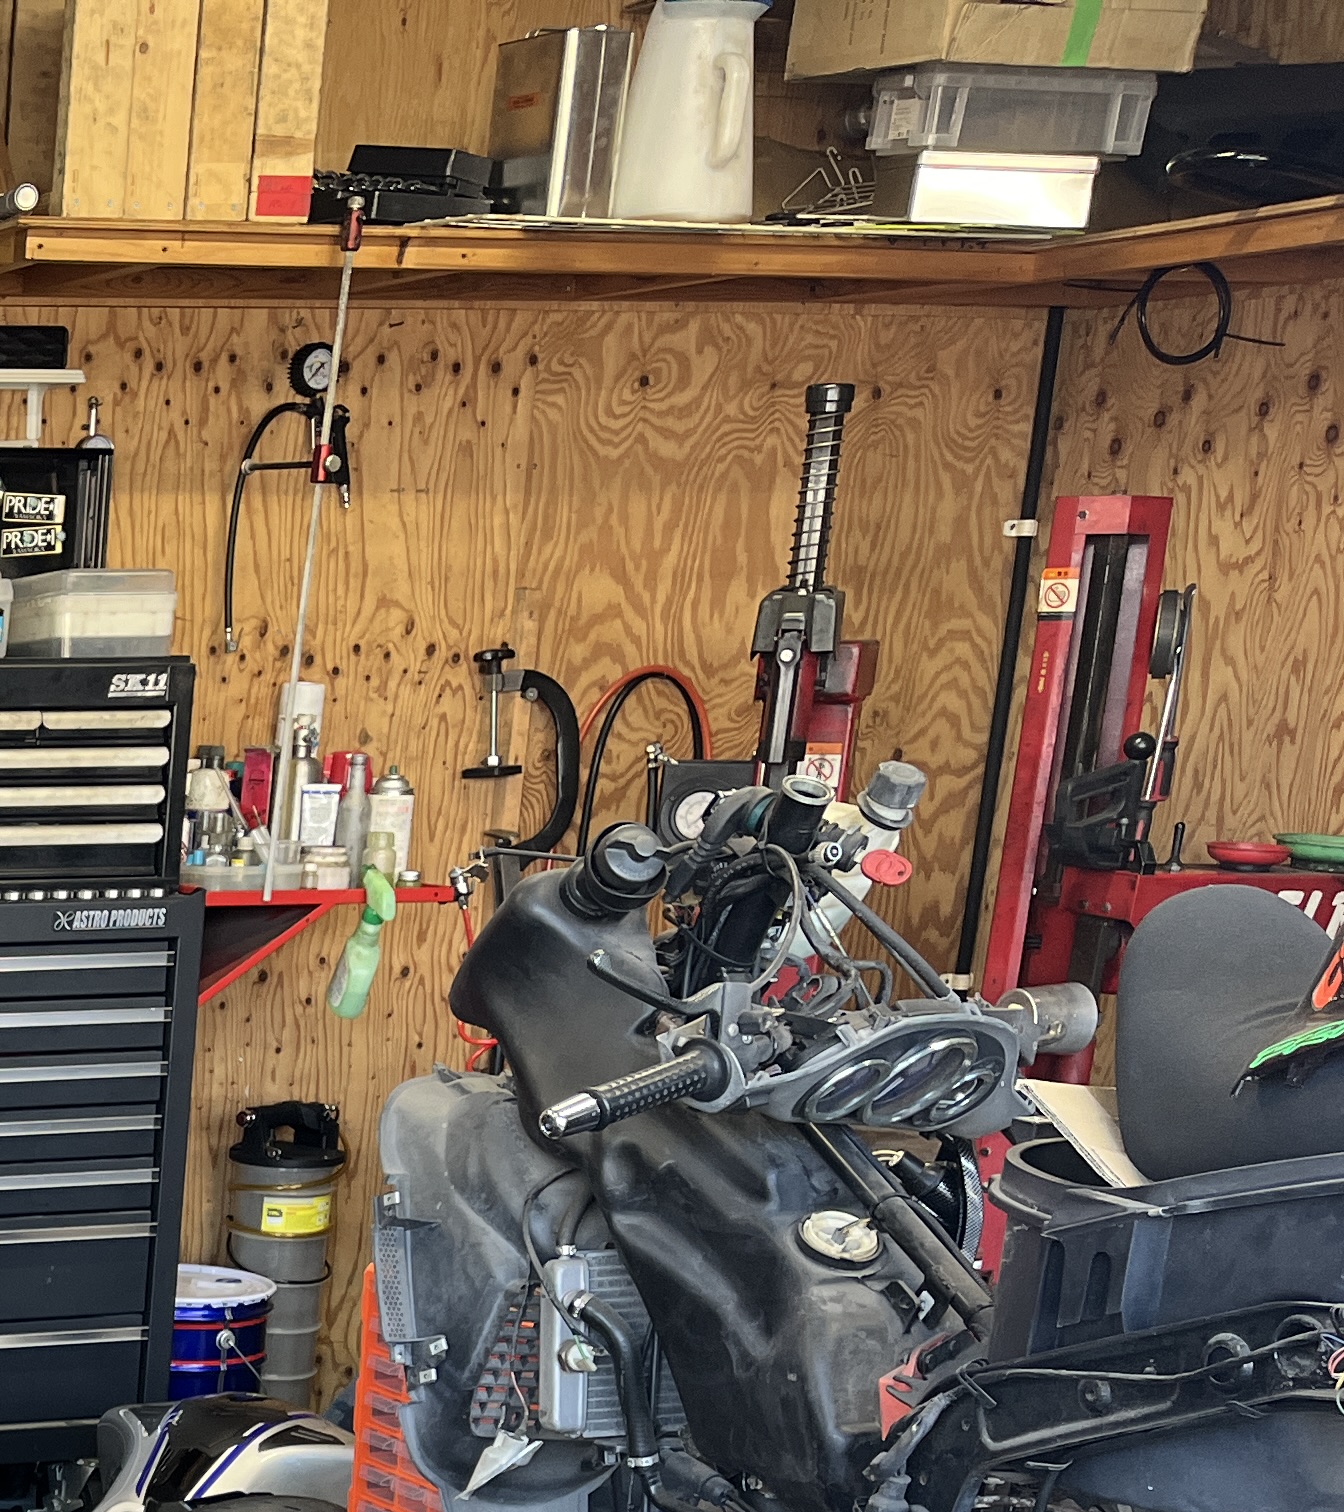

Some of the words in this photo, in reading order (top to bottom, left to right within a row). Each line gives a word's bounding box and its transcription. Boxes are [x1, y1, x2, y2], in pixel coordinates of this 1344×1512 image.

[109, 673, 168, 691] SK11
[73, 909, 109, 928] ASTRO
[109, 907, 167, 927] PRODUCTS
